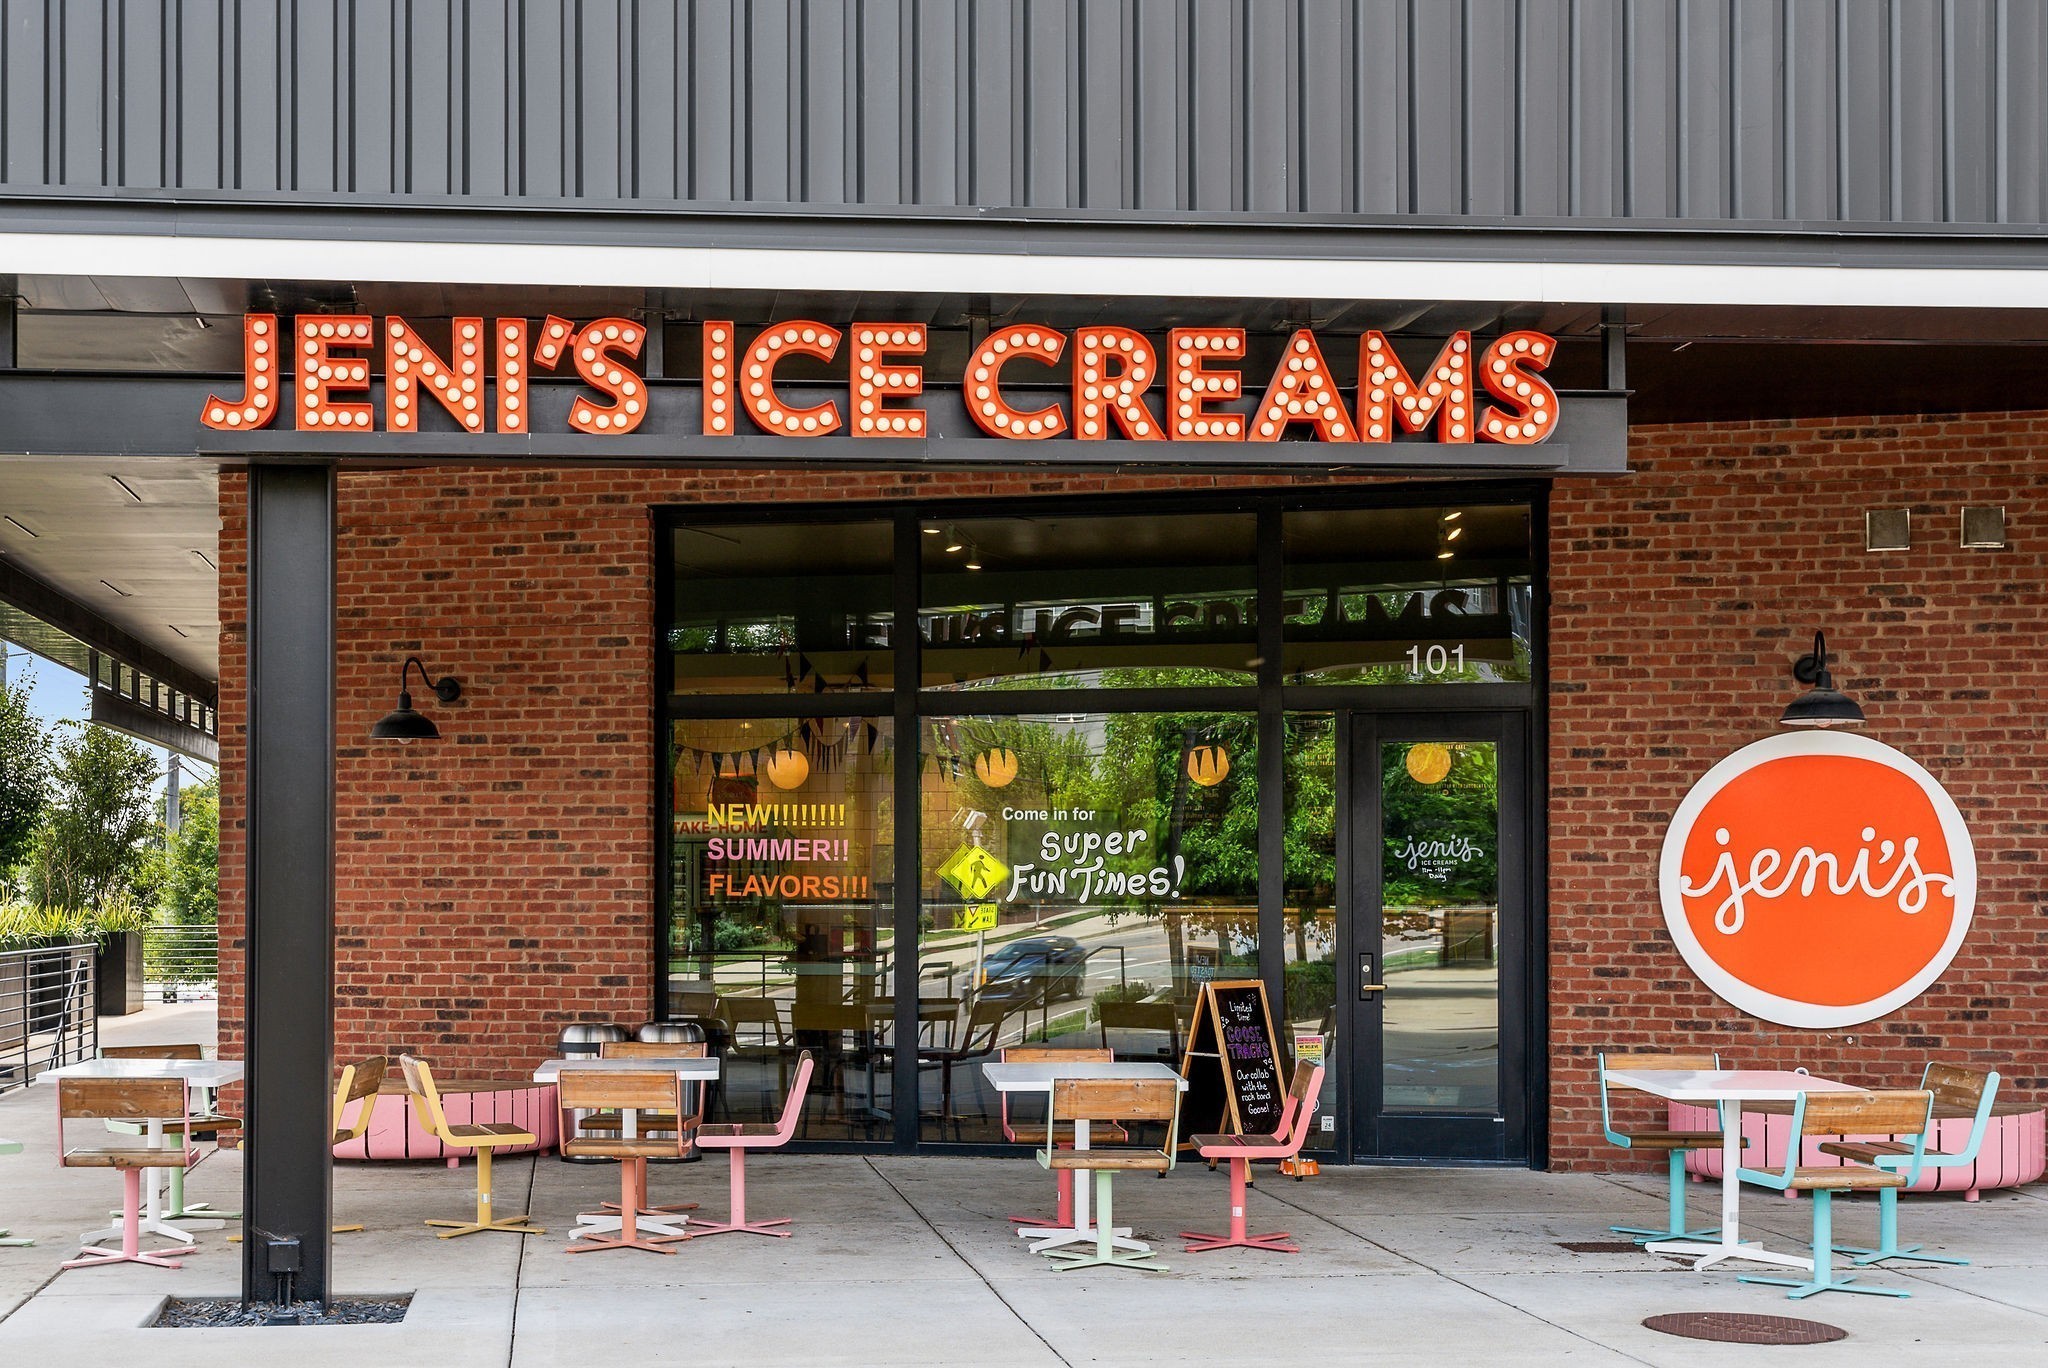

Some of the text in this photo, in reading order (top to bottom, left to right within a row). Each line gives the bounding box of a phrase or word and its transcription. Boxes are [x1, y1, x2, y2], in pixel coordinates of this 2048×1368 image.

[200, 312, 1560, 446] JENI'S ICE CREAMS
[1405, 643, 1464, 677] 101
[707, 803, 845, 826] NEW!!!!!!!!
[1002, 807, 1096, 821] Come in for
[707, 837, 849, 862] SUMMER!!
[1395, 834, 1484, 869] jeni's
[708, 874, 868, 898] FLAVORS!!!
[1679, 827, 1957, 934] jeni's
[1228, 1001, 1253, 1013] Limited
[1226, 1026, 1263, 1043] GOOSE
[1226, 1042, 1270, 1060] TRACKS
[1236, 1067, 1270, 1080] Our collab
[1241, 1080, 1268, 1092] with the
[1241, 1091, 1271, 1102] rock band
[1247, 1102, 1270, 1115] Goose!
